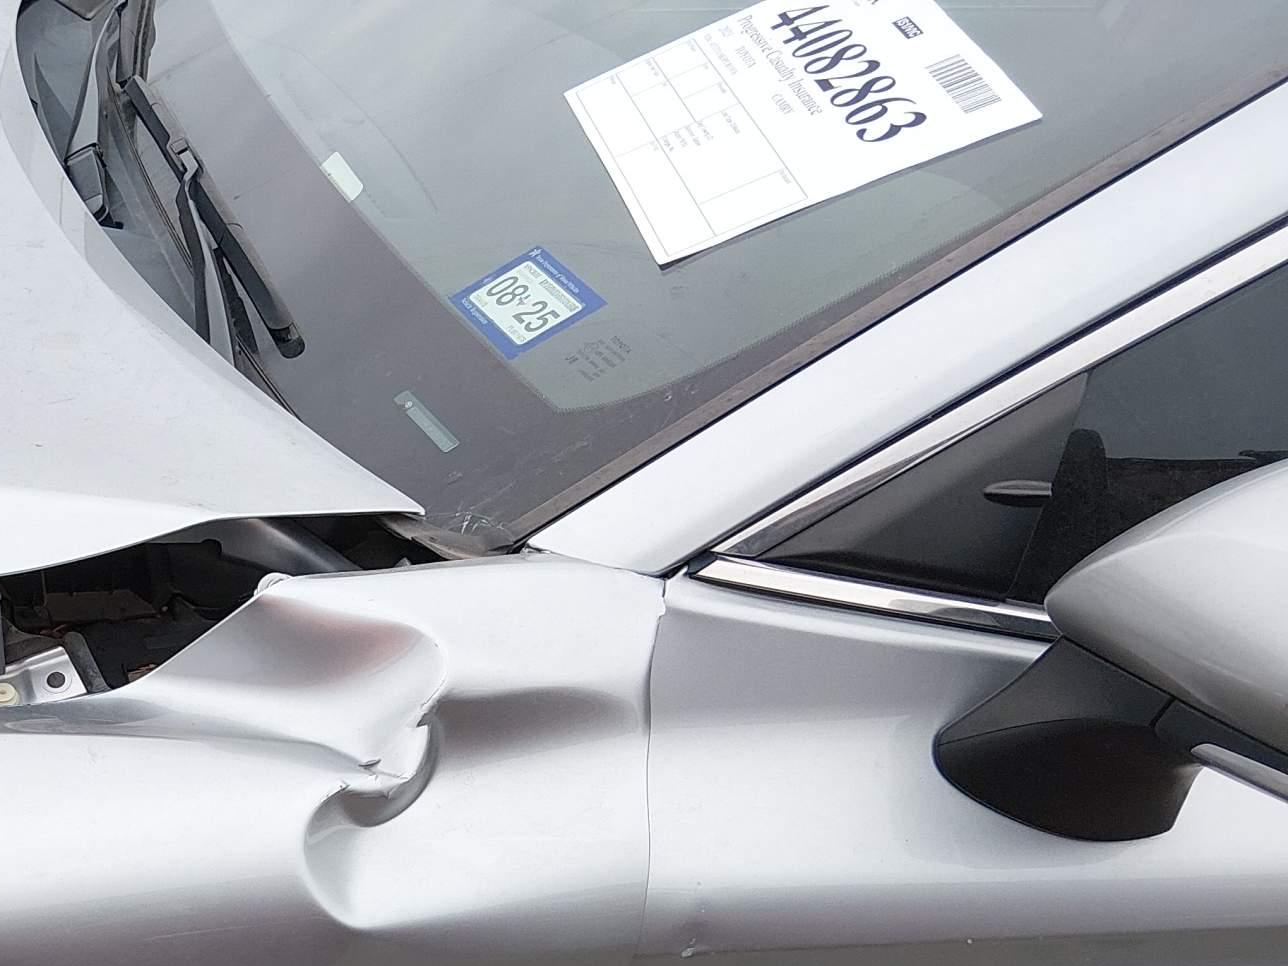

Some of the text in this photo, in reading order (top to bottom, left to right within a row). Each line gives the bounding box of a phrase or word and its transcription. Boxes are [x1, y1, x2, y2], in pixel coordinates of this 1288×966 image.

[770, 4, 927, 142] 44082863
[787, 73, 823, 116] Insurance
[485, 275, 529, 306] 08
[512, 299, 561, 333] 25
